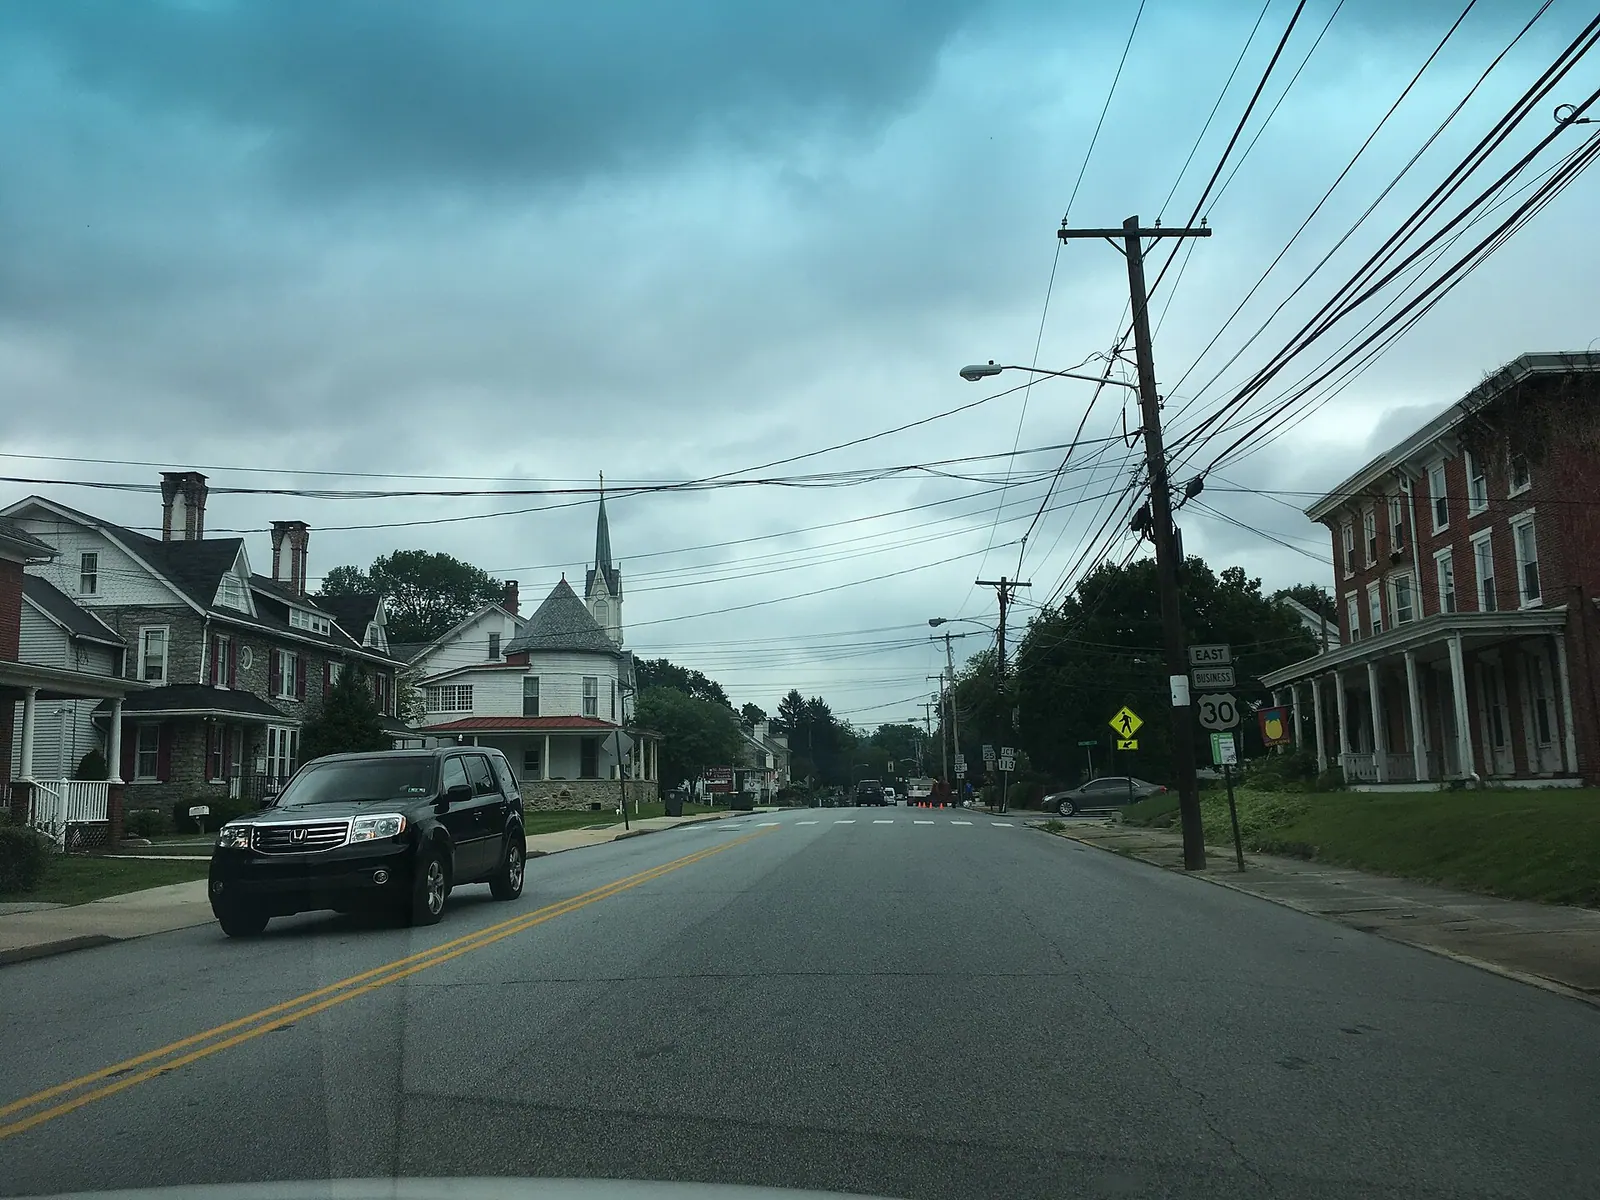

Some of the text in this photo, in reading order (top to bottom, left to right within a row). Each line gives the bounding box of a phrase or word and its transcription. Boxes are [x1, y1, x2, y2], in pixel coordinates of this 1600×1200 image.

[1195, 649, 1224, 661] EAST
[1196, 672, 1231, 684] BUSINESS
[1203, 701, 1233, 724] 30
[1000, 760, 1014, 769] 113
